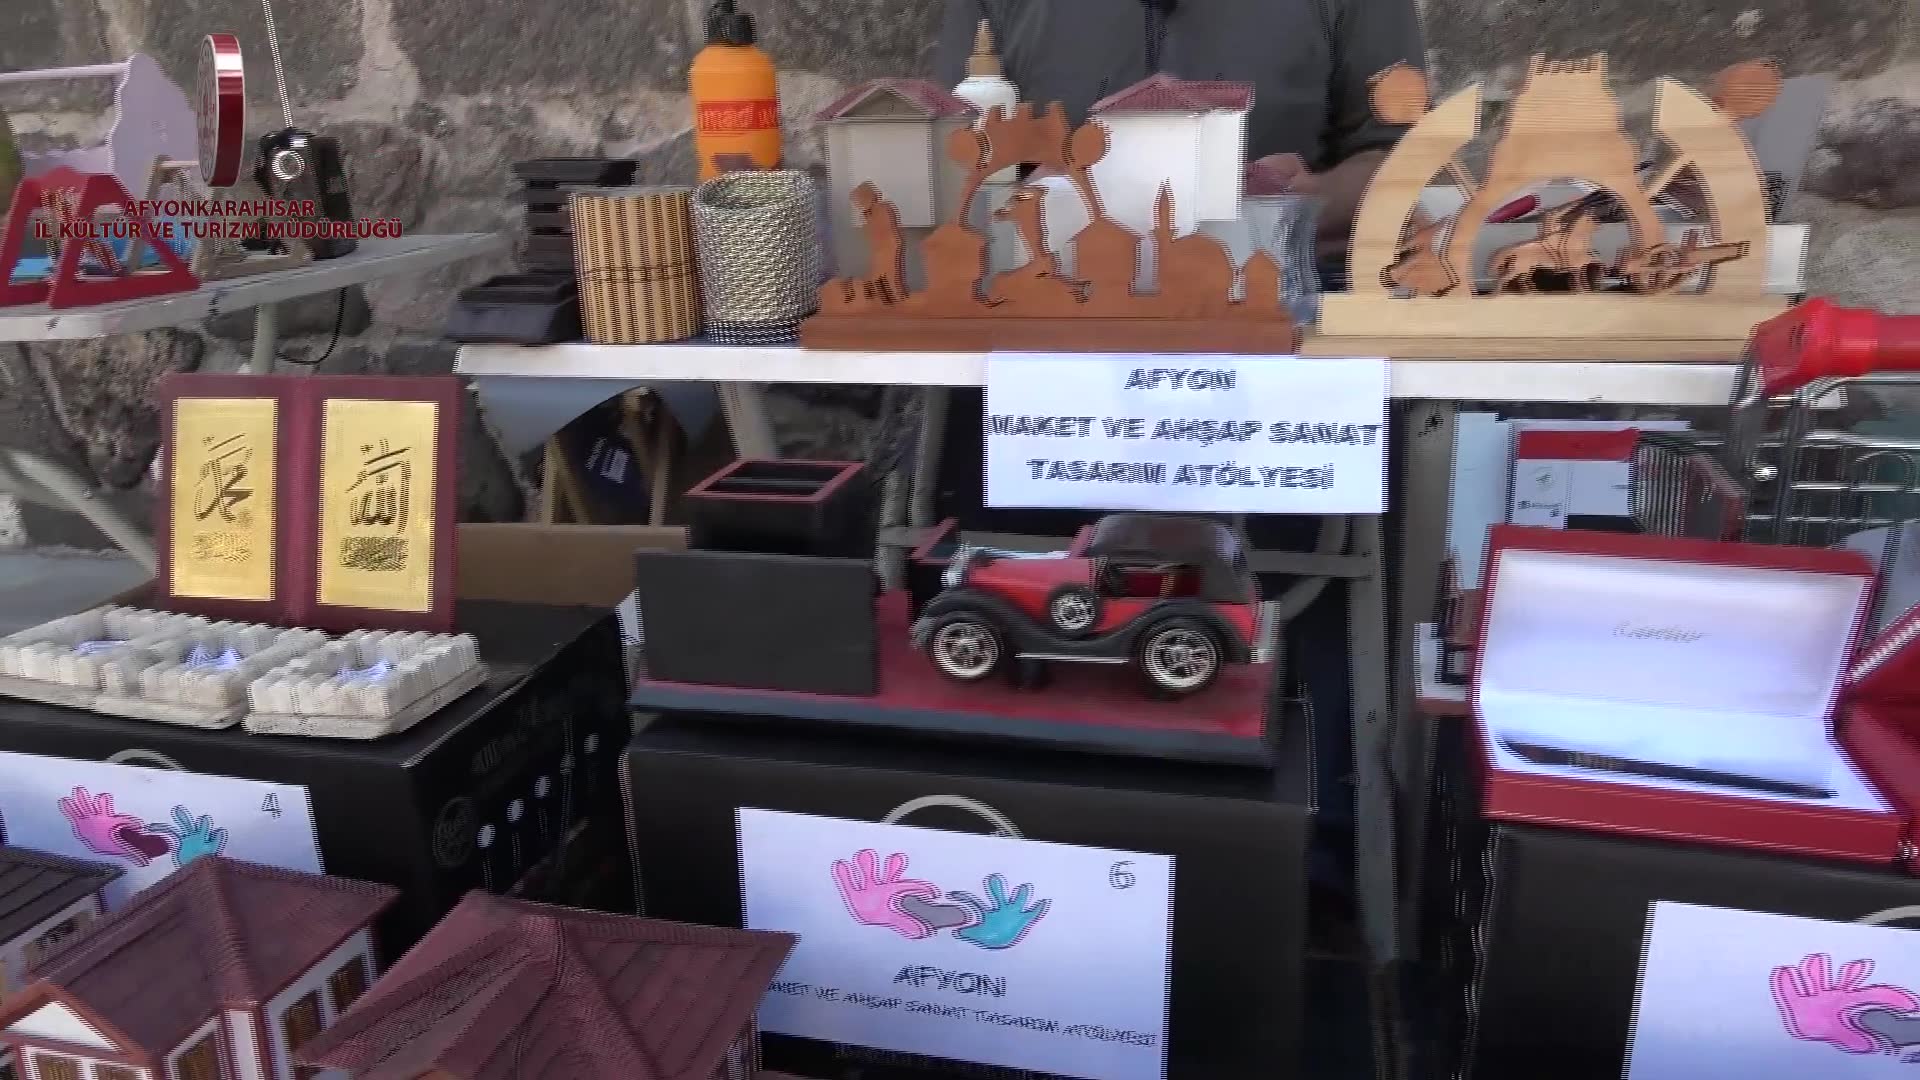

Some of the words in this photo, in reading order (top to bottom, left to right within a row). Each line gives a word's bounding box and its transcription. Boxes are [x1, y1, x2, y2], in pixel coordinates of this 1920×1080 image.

[1124, 368, 1237, 390] AFYON
[989, 414, 1096, 438] MAKET
[1102, 416, 1146, 439] VE
[1151, 419, 1262, 447] AHŞAP
[1268, 421, 1382, 446] SANAT
[1026, 457, 1166, 485] TASARIM
[1172, 460, 1335, 489] ATÖLYESİ
[261, 792, 282, 819] 4
[1108, 860, 1136, 889] 6
[893, 964, 1007, 998] AFYON
